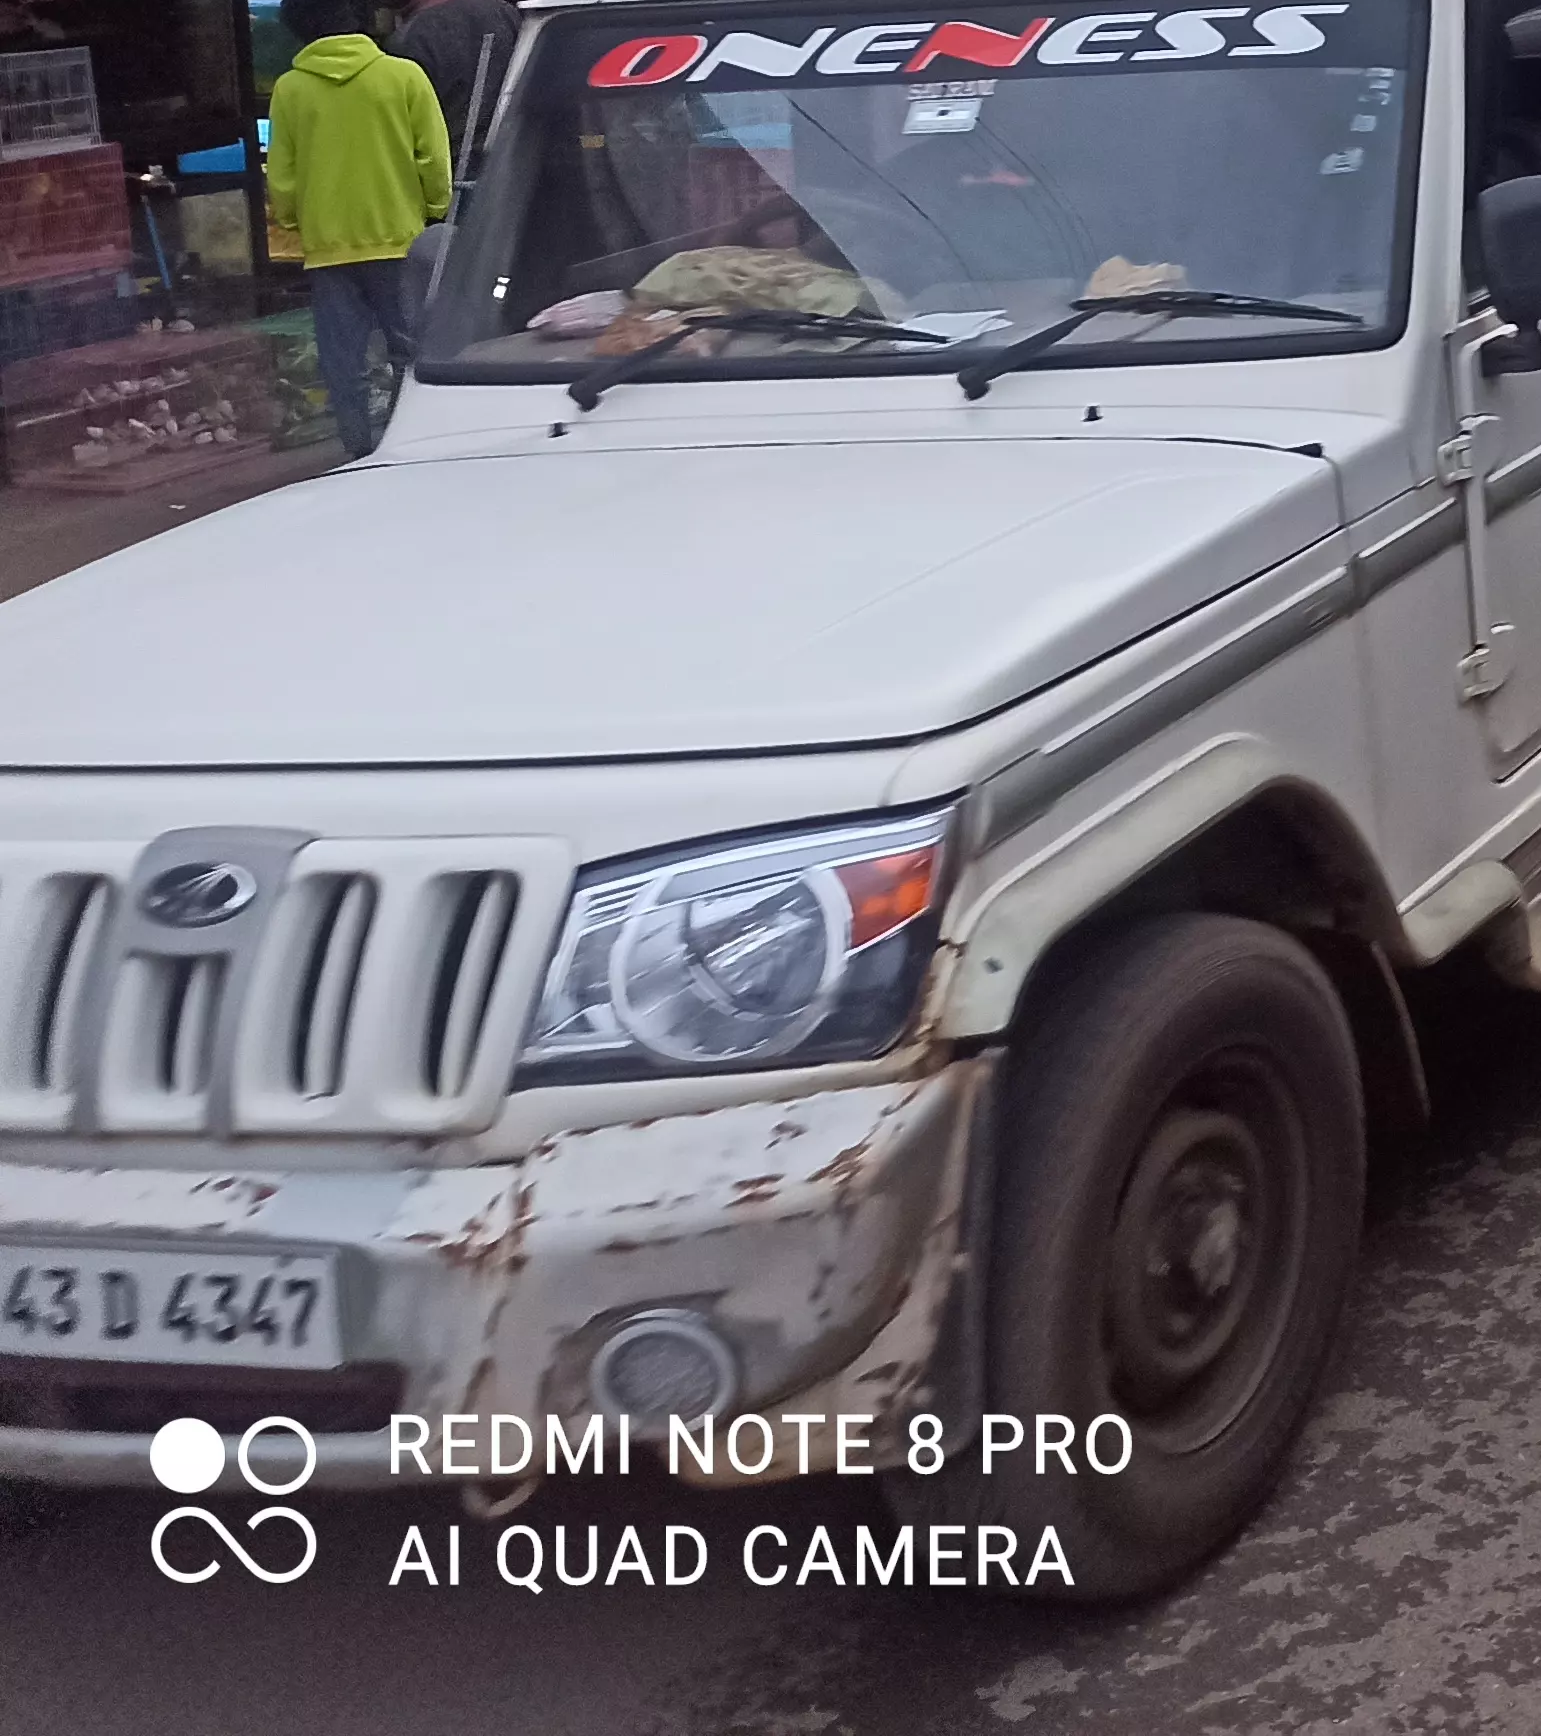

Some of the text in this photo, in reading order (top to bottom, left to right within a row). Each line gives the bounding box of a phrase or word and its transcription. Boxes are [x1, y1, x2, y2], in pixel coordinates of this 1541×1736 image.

[586, 3, 1349, 89] ONENESS
[2, 1264, 318, 1346] 43 D 4347
